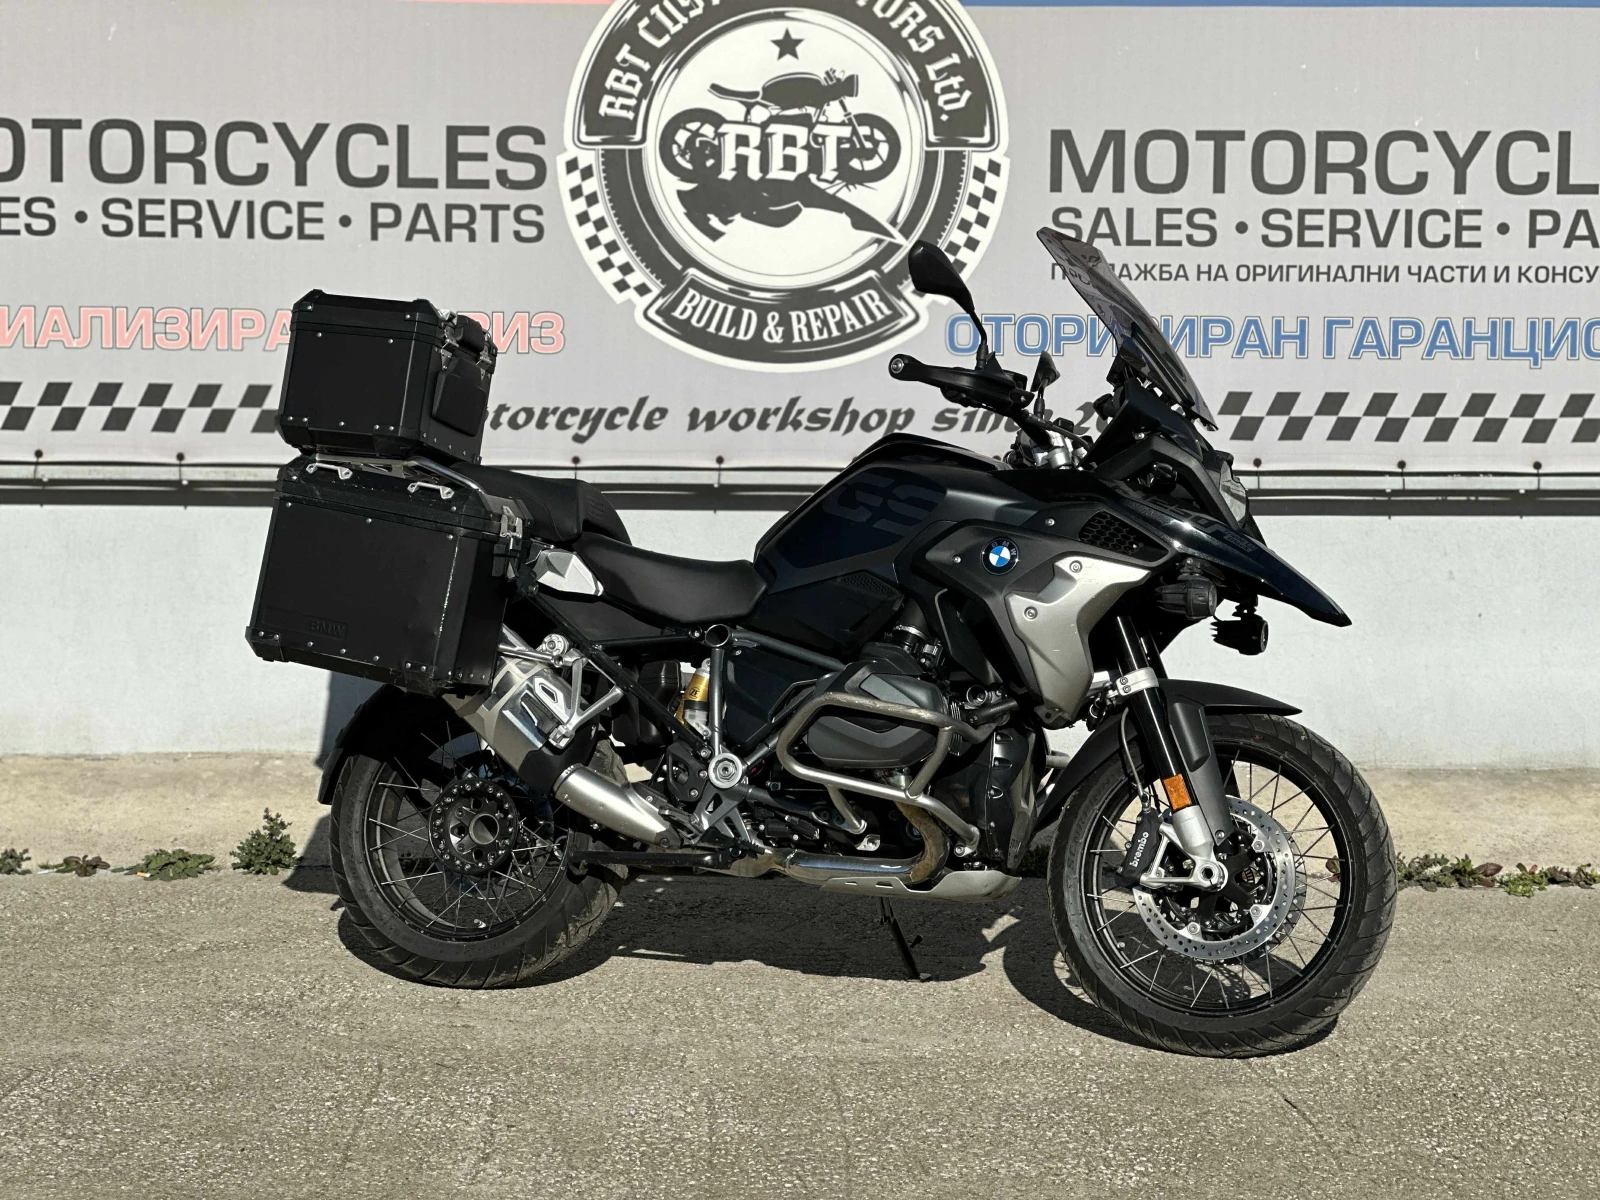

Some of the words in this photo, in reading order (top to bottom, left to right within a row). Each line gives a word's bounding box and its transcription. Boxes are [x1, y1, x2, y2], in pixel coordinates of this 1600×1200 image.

[598, 43, 651, 120] RBT
[925, 52, 972, 122] Ltd.
[717, 122, 852, 182] RBT
[1050, 129, 1600, 196] MOTORCYCL
[0, 196, 56, 237] ES
[101, 197, 325, 241] SERVICE
[370, 203, 545, 244] PARTS
[1051, 207, 1218, 248] SALES
[1261, 208, 1483, 249] SERVICE
[1528, 209, 1600, 249] PA
[1196, 264, 1229, 282] НА
[1236, 264, 1400, 283] ОРИГИНАЛНИ
[1407, 265, 1486, 283] ЧАСТИ
[1493, 265, 1510, 283] И
[1517, 265, 1600, 284] КОНСУ
[671, 287, 758, 342] BUILD
[762, 311, 785, 344] &
[788, 289, 893, 344] REPAIR
[947, 313, 1310, 360] ОТОРИИРАН
[485, 395, 669, 445] torcycle
[687, 396, 916, 437] workshop
[1129, 831, 1149, 868] brembo
